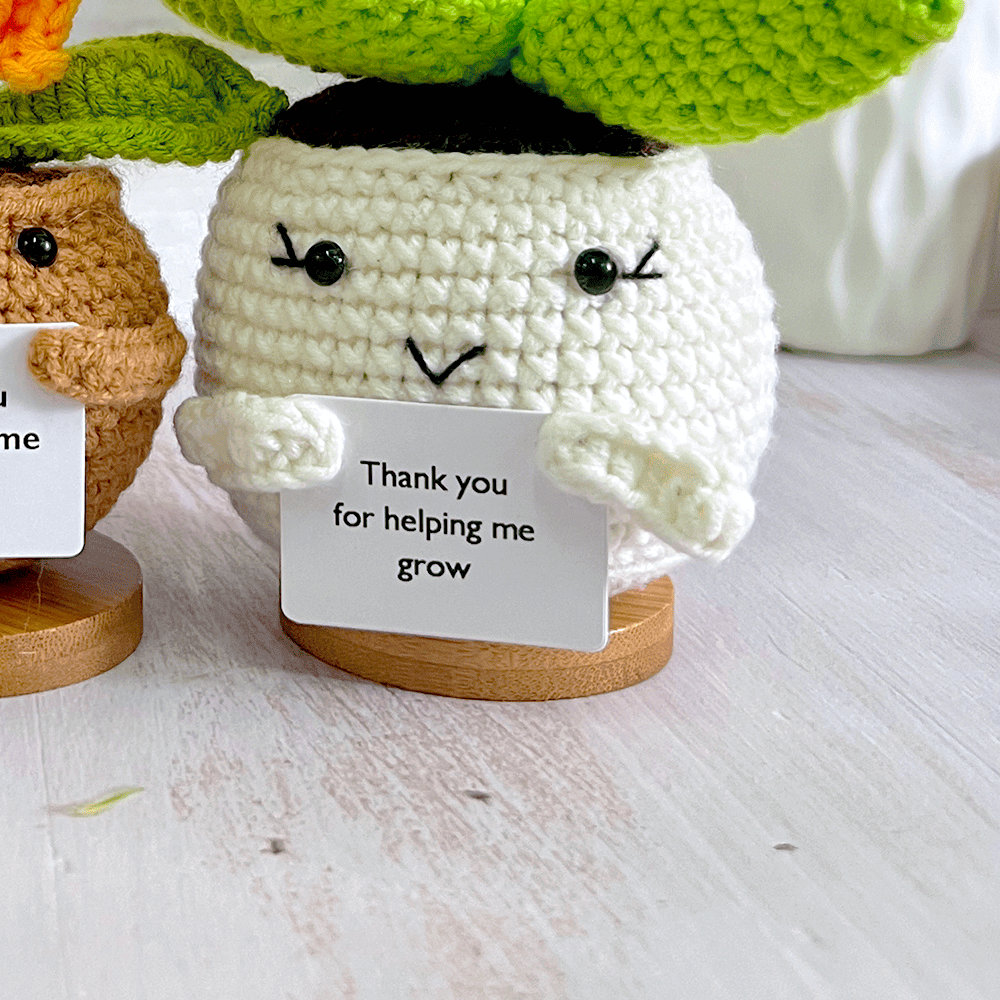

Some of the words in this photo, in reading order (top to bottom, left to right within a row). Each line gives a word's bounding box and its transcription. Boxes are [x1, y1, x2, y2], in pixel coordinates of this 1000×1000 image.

[360, 460, 448, 491] Thank
[455, 474, 508, 499] you
[333, 502, 375, 529] for
[384, 507, 482, 544] helping
[492, 521, 535, 542] me
[397, 557, 472, 583] grow
